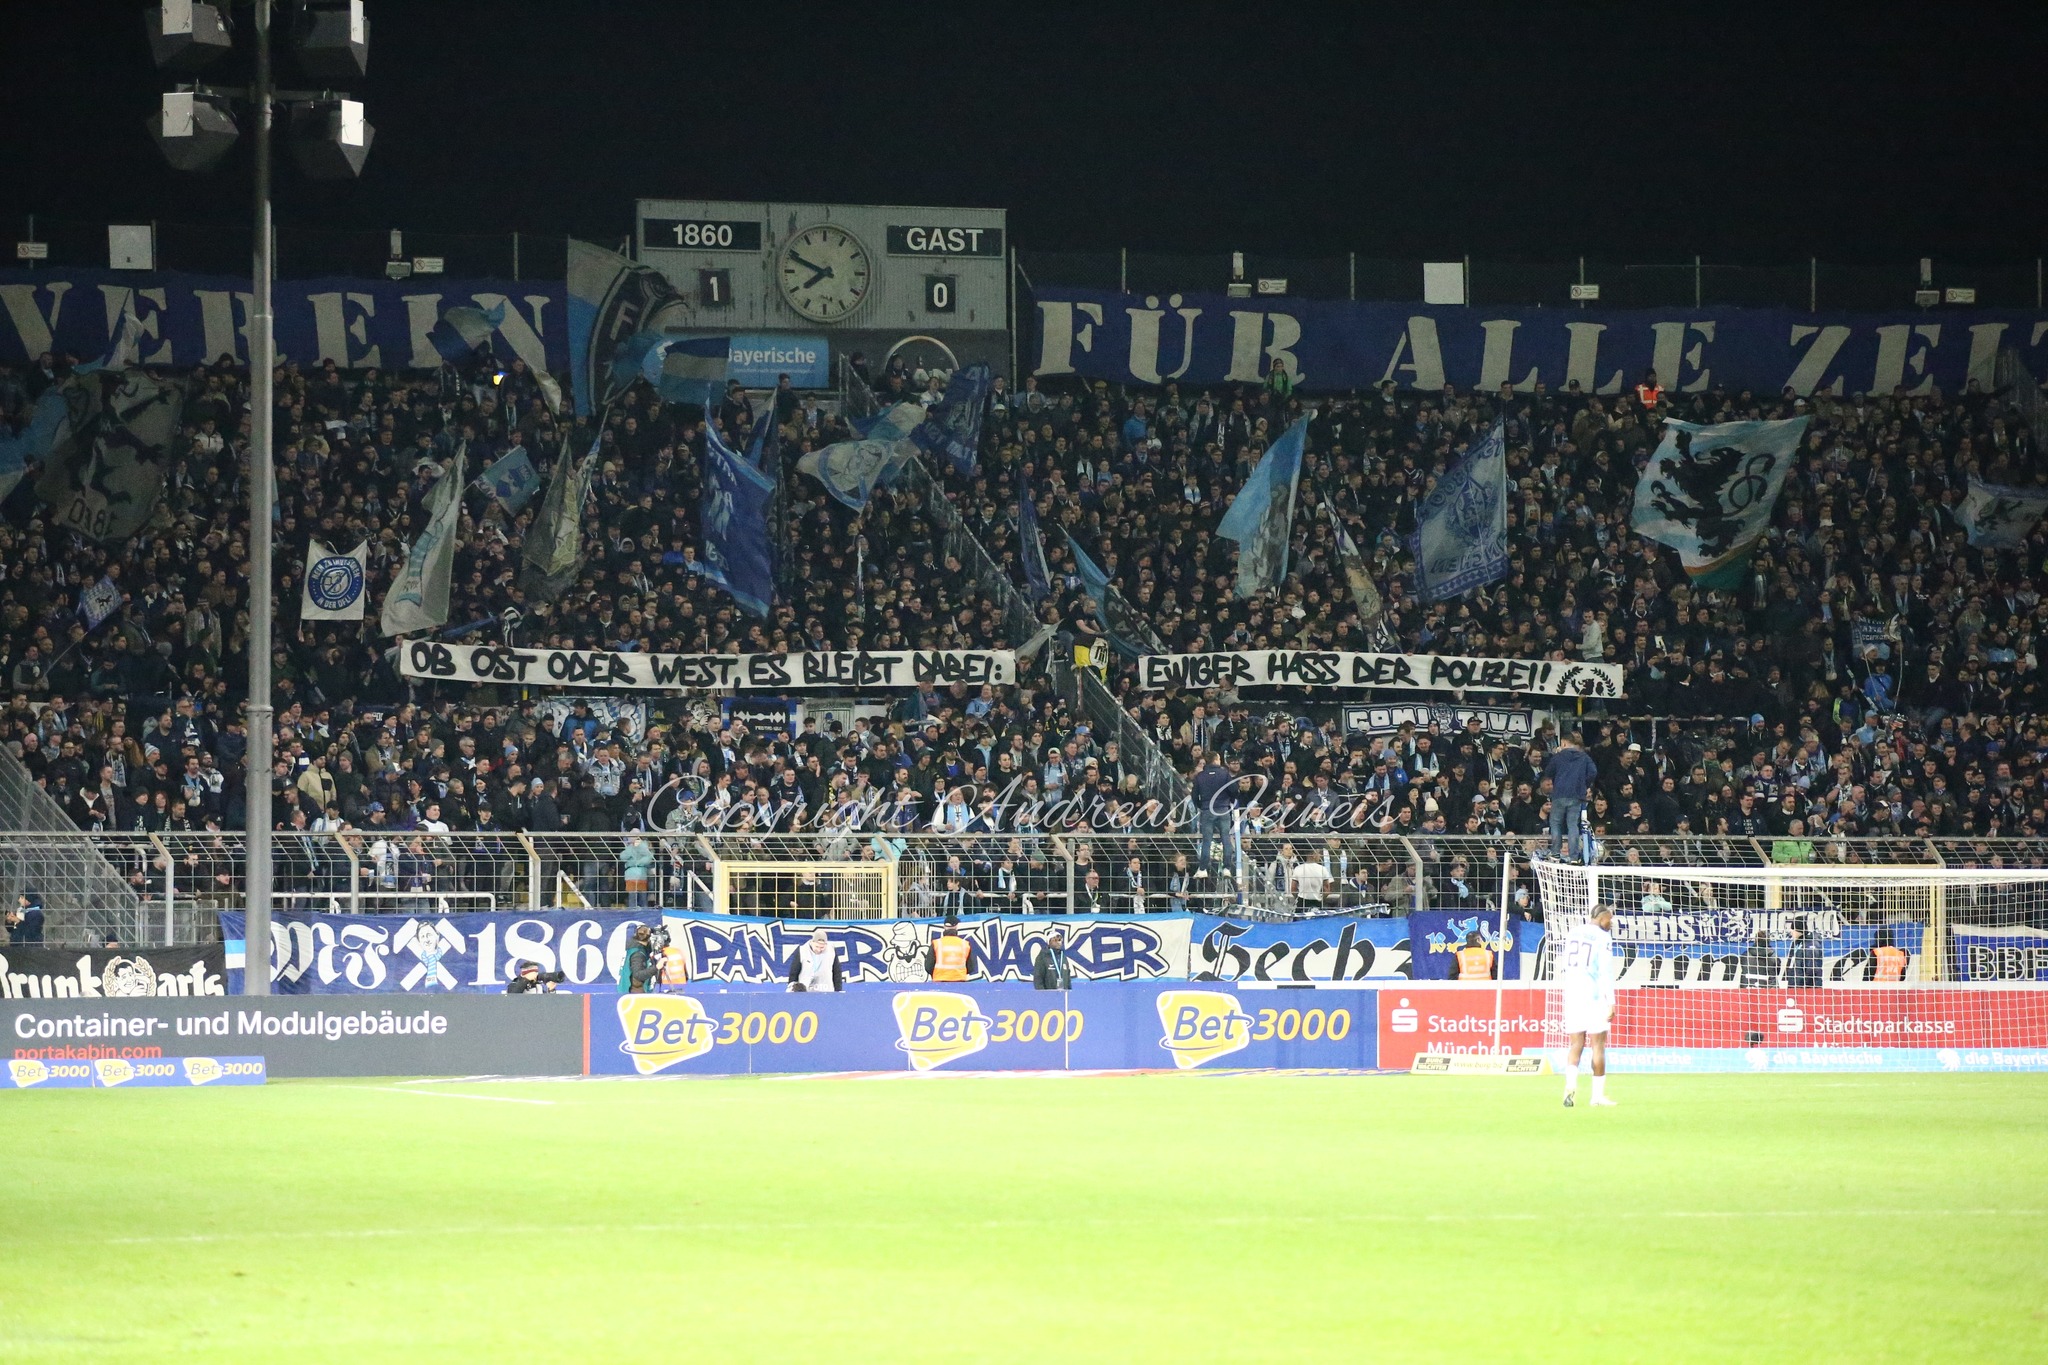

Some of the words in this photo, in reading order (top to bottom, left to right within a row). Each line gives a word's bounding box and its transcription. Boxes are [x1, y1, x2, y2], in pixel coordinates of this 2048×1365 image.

[672, 223, 733, 247] 1860
[906, 227, 984, 252] GAST
[709, 276, 719, 302] 1
[932, 282, 948, 308] 0
[1033, 293, 1305, 385] FÜR
[1375, 315, 1716, 395] ALLE
[1780, 320, 2048, 397] ZEI
[410, 641, 456, 676] OB
[470, 646, 538, 682] OST
[547, 651, 637, 686] ODER
[749, 653, 791, 686] ES
[803, 651, 903, 686] BLEIBT
[913, 651, 1002, 684] DABEI:
[1146, 655, 1255, 688] EWIGER
[1267, 652, 1341, 685] HASS
[1352, 657, 1420, 688] DER
[1568, 940, 1592, 967] 27
[15, 1012, 169, 1039] Container-
[176, 1011, 230, 1036] und
[237, 1010, 448, 1040] Modulgebäude
[633, 1010, 697, 1046] Bet
[716, 1011, 818, 1045] 3000
[909, 1006, 973, 1042] Bet
[990, 1008, 1084, 1043] 3000
[1173, 1005, 1236, 1042] Bet
[1252, 1007, 1351, 1042] 3000
[1813, 1014, 1955, 1037] Stadtsparkasse
[14, 1043, 162, 1060] portakabin.com
[48, 1065, 90, 1078] 3000
[134, 1064, 175, 1077] 3000
[223, 1062, 263, 1076] 3000
